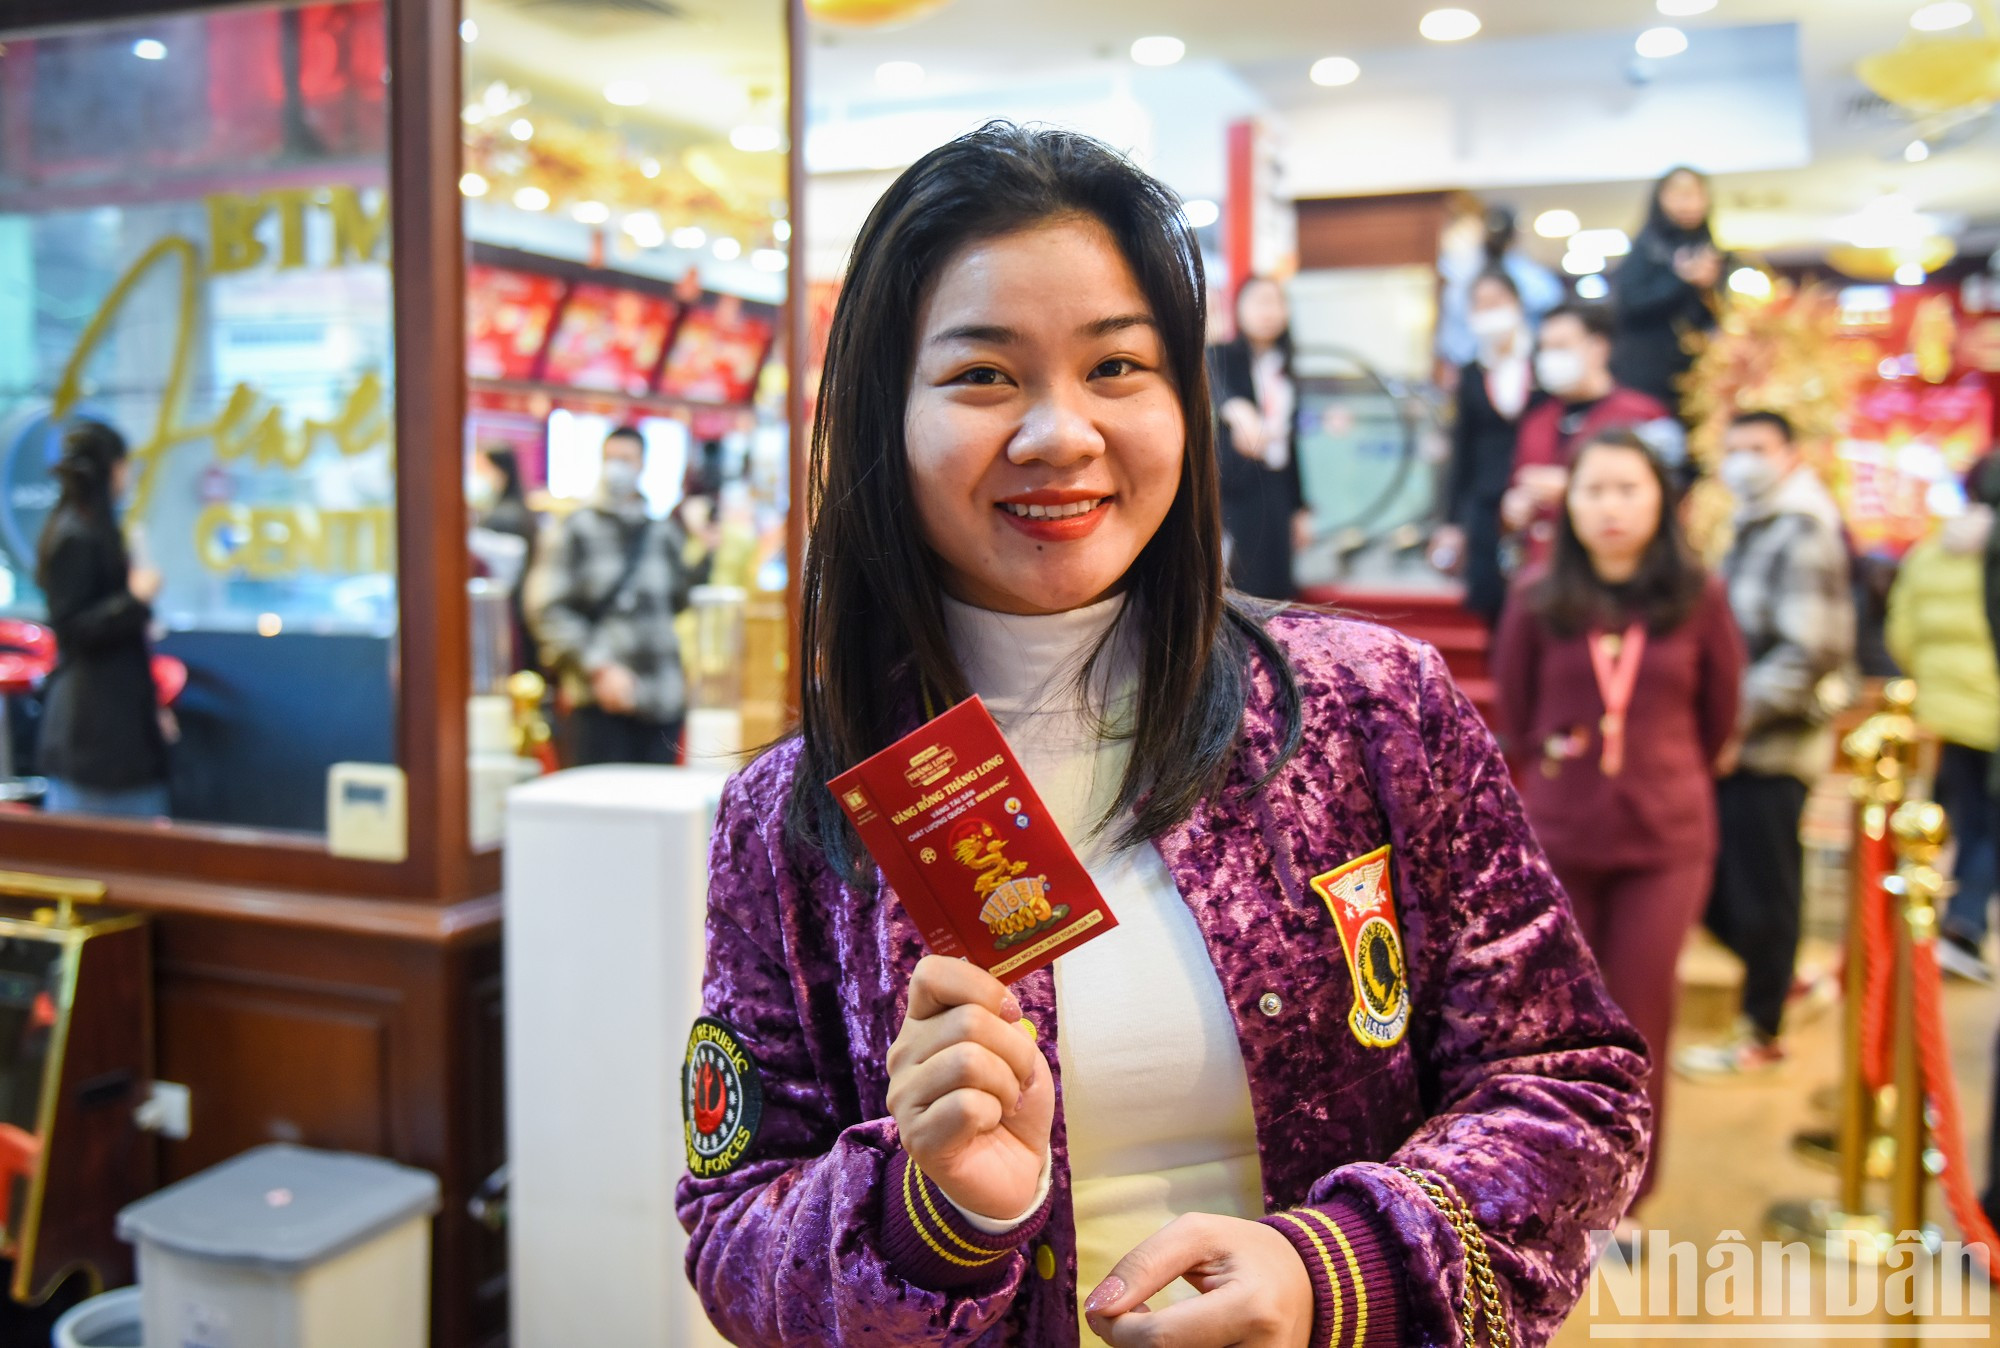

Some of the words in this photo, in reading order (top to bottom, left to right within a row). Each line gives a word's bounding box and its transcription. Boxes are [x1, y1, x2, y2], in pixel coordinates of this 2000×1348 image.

[976, 754, 1004, 776] LONG
[696, 1023, 748, 1074] REPUBLIC
[704, 1125, 750, 1175] FORCES
